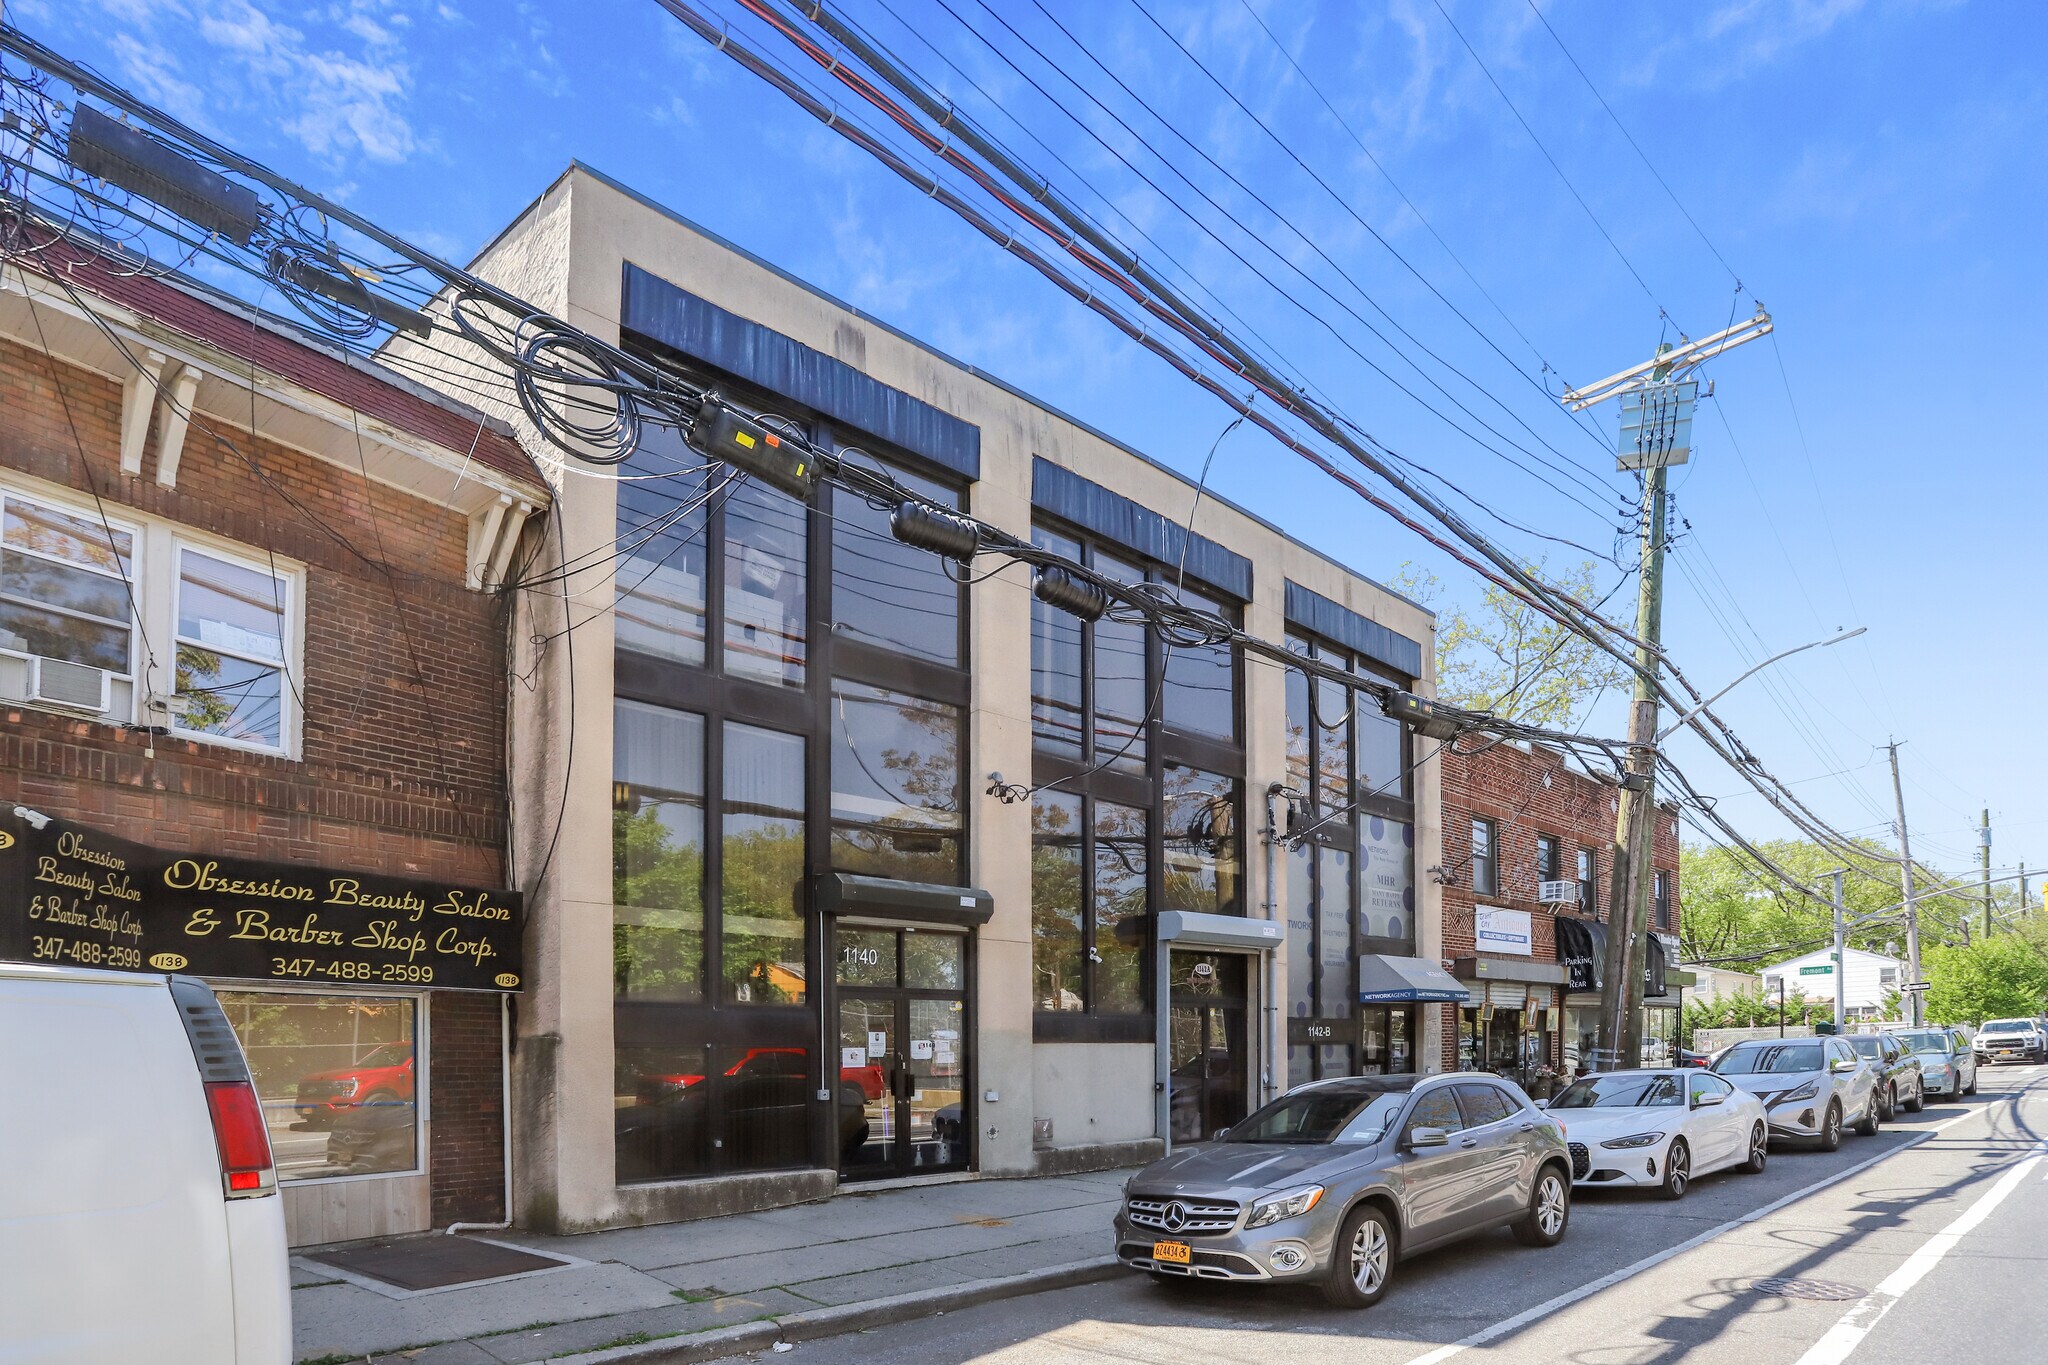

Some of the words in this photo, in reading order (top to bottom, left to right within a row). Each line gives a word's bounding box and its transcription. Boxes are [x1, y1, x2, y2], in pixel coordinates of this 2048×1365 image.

[57, 831, 126, 871] Obsession
[34, 856, 95, 901] Beauty
[98, 872, 142, 902] Salon
[163, 859, 316, 901] Obsession
[322, 878, 426, 922] Beauty
[432, 890, 511, 921] Salon
[1377, 874, 1396, 887] MHR
[1371, 897, 1401, 908] RETURNS
[29, 895, 44, 919] &
[45, 895, 88, 927] Barber
[89, 904, 118, 941] Shop
[120, 910, 144, 944] Corp.
[184, 908, 222, 936] &
[228, 909, 344, 946] Barber
[351, 920, 427, 963] Shop
[435, 927, 497, 967] Corp.
[32, 935, 141, 969] 347-488-2599
[154, 956, 183, 967] 1138
[843, 946, 878, 966] 1140
[271, 957, 434, 983] 347-488-2599
[497, 976, 517, 985] 1138
[1800, 967, 1825, 975] Fremont
[1307, 1026, 1331, 1037] 1142-B
